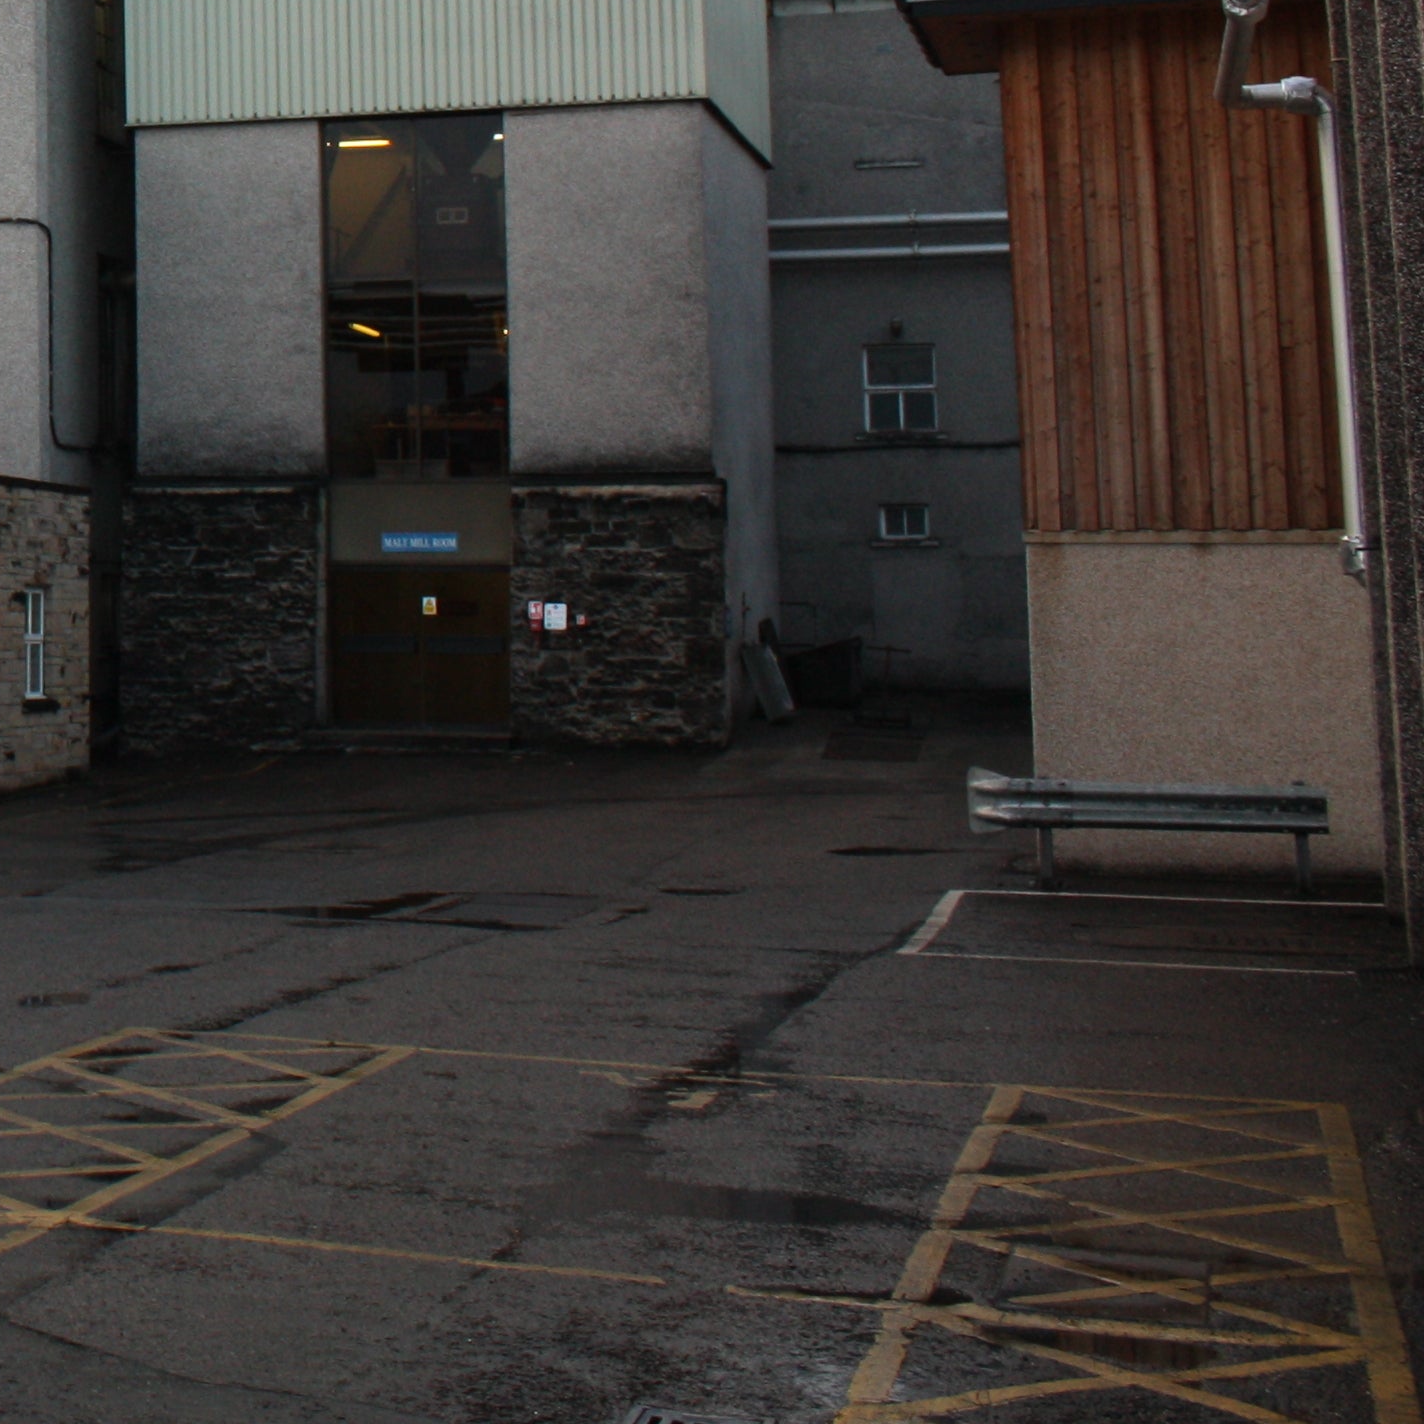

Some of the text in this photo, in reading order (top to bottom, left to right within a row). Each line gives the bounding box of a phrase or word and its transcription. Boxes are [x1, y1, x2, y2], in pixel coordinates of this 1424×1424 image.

[383, 537, 457, 548] MALT MILL ROOM
